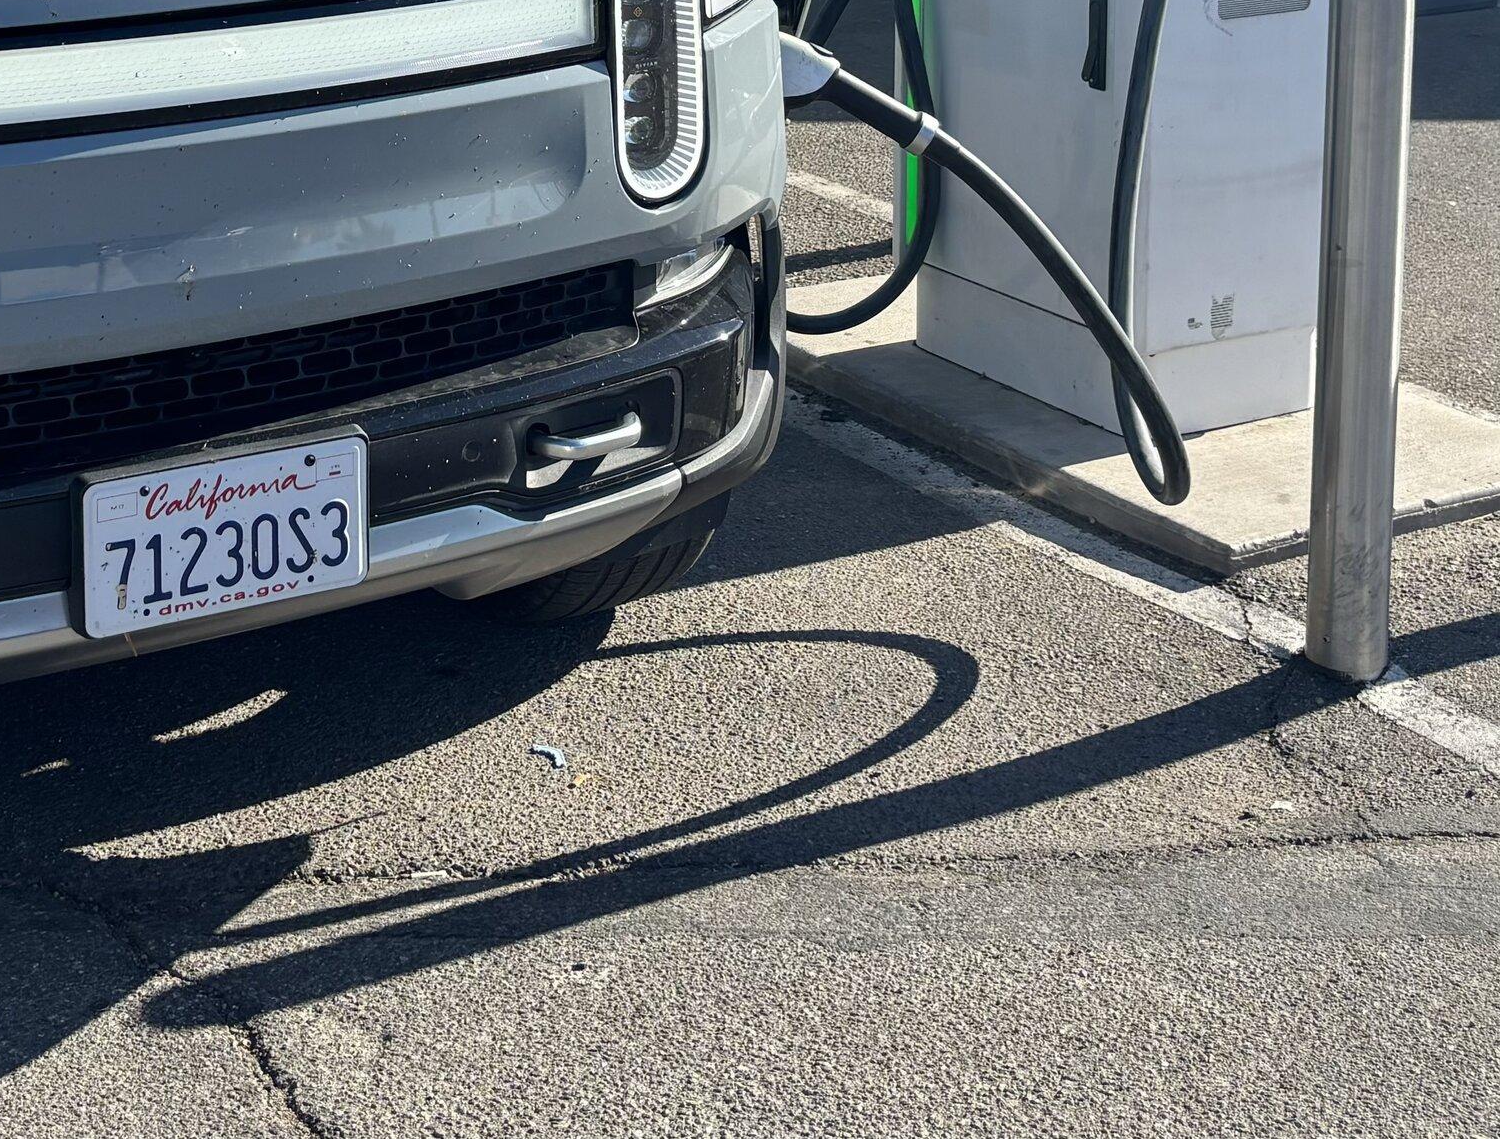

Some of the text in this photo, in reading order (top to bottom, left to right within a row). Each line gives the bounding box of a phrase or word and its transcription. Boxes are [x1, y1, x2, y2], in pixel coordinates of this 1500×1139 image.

[145, 471, 317, 521] California
[105, 498, 351, 610] 71230S3
[159, 579, 300, 616] dmv.ca.gov
